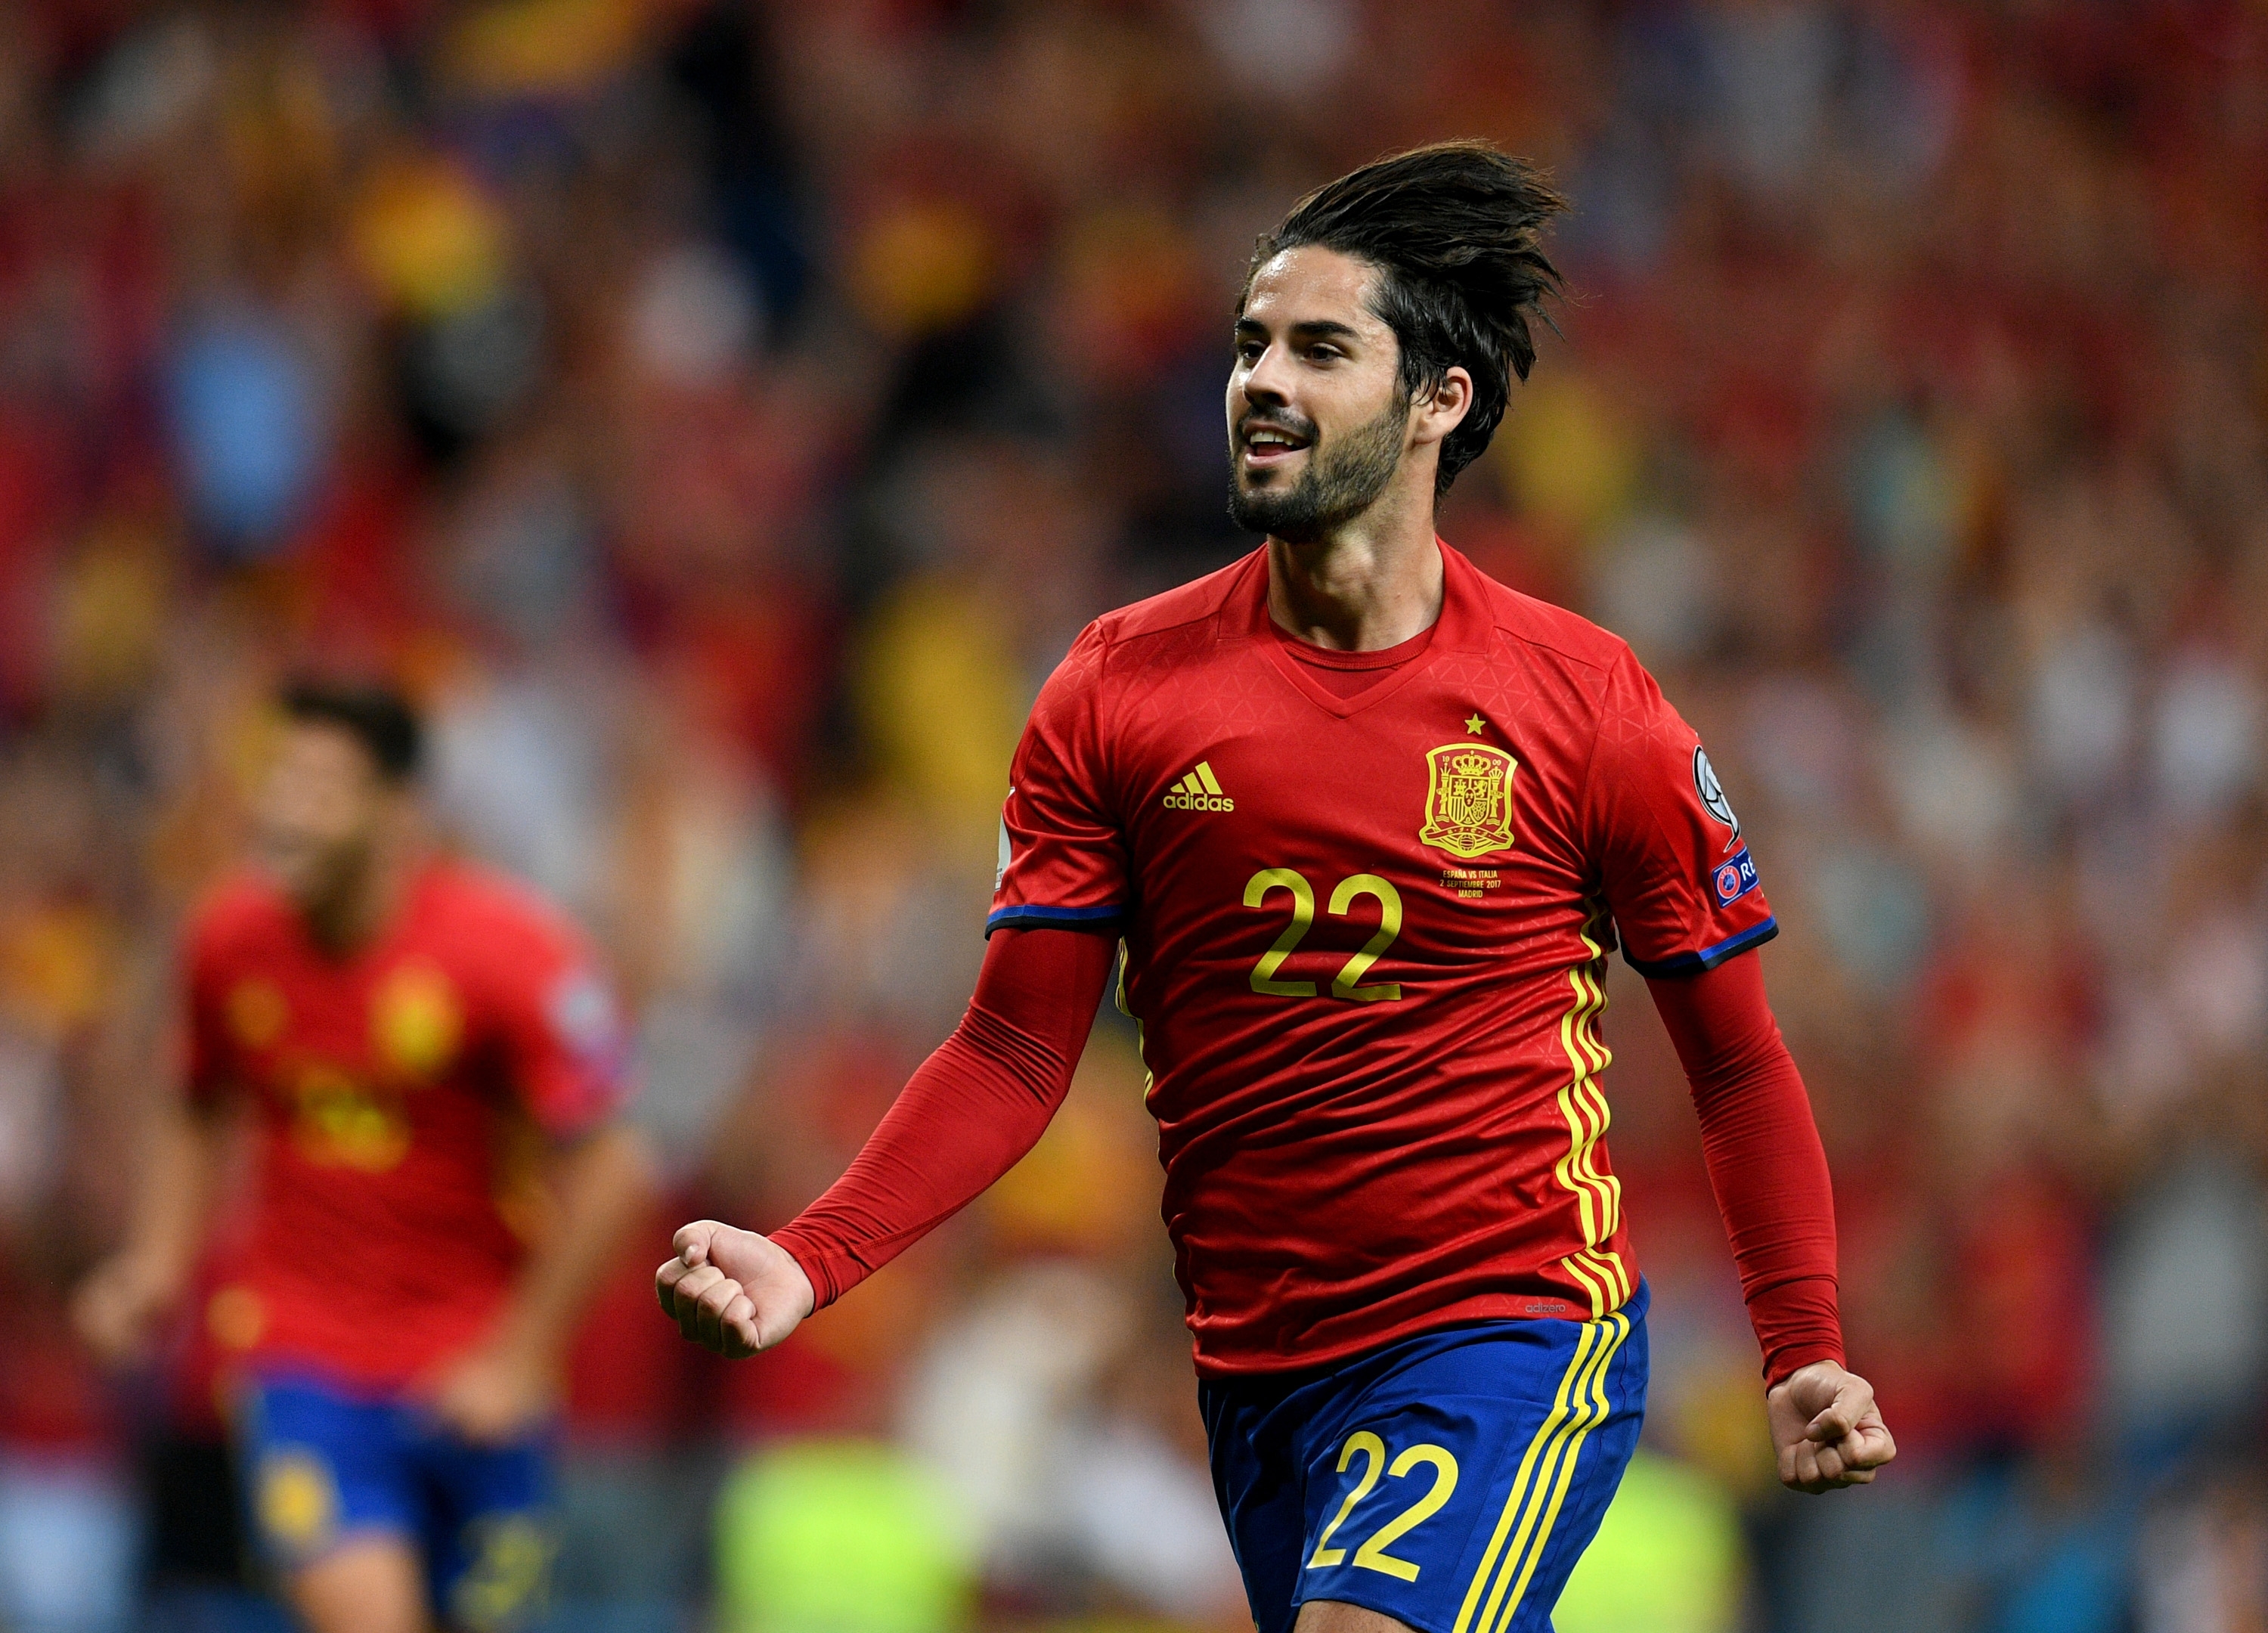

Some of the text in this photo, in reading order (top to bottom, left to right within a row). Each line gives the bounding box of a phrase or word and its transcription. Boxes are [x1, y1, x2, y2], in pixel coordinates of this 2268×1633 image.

[1163, 792, 1235, 812] adidas
[1442, 869, 1498, 878] ESPAÑA VS ITALIA
[1446, 880, 1484, 888] SEPTIEMBRE
[1486, 880, 1501, 888] 2017
[1458, 890, 1483, 898] MADRID
[1243, 868, 1402, 1002] 22
[1525, 1303, 1566, 1313] adizero
[1306, 1430, 1458, 1583] 22
